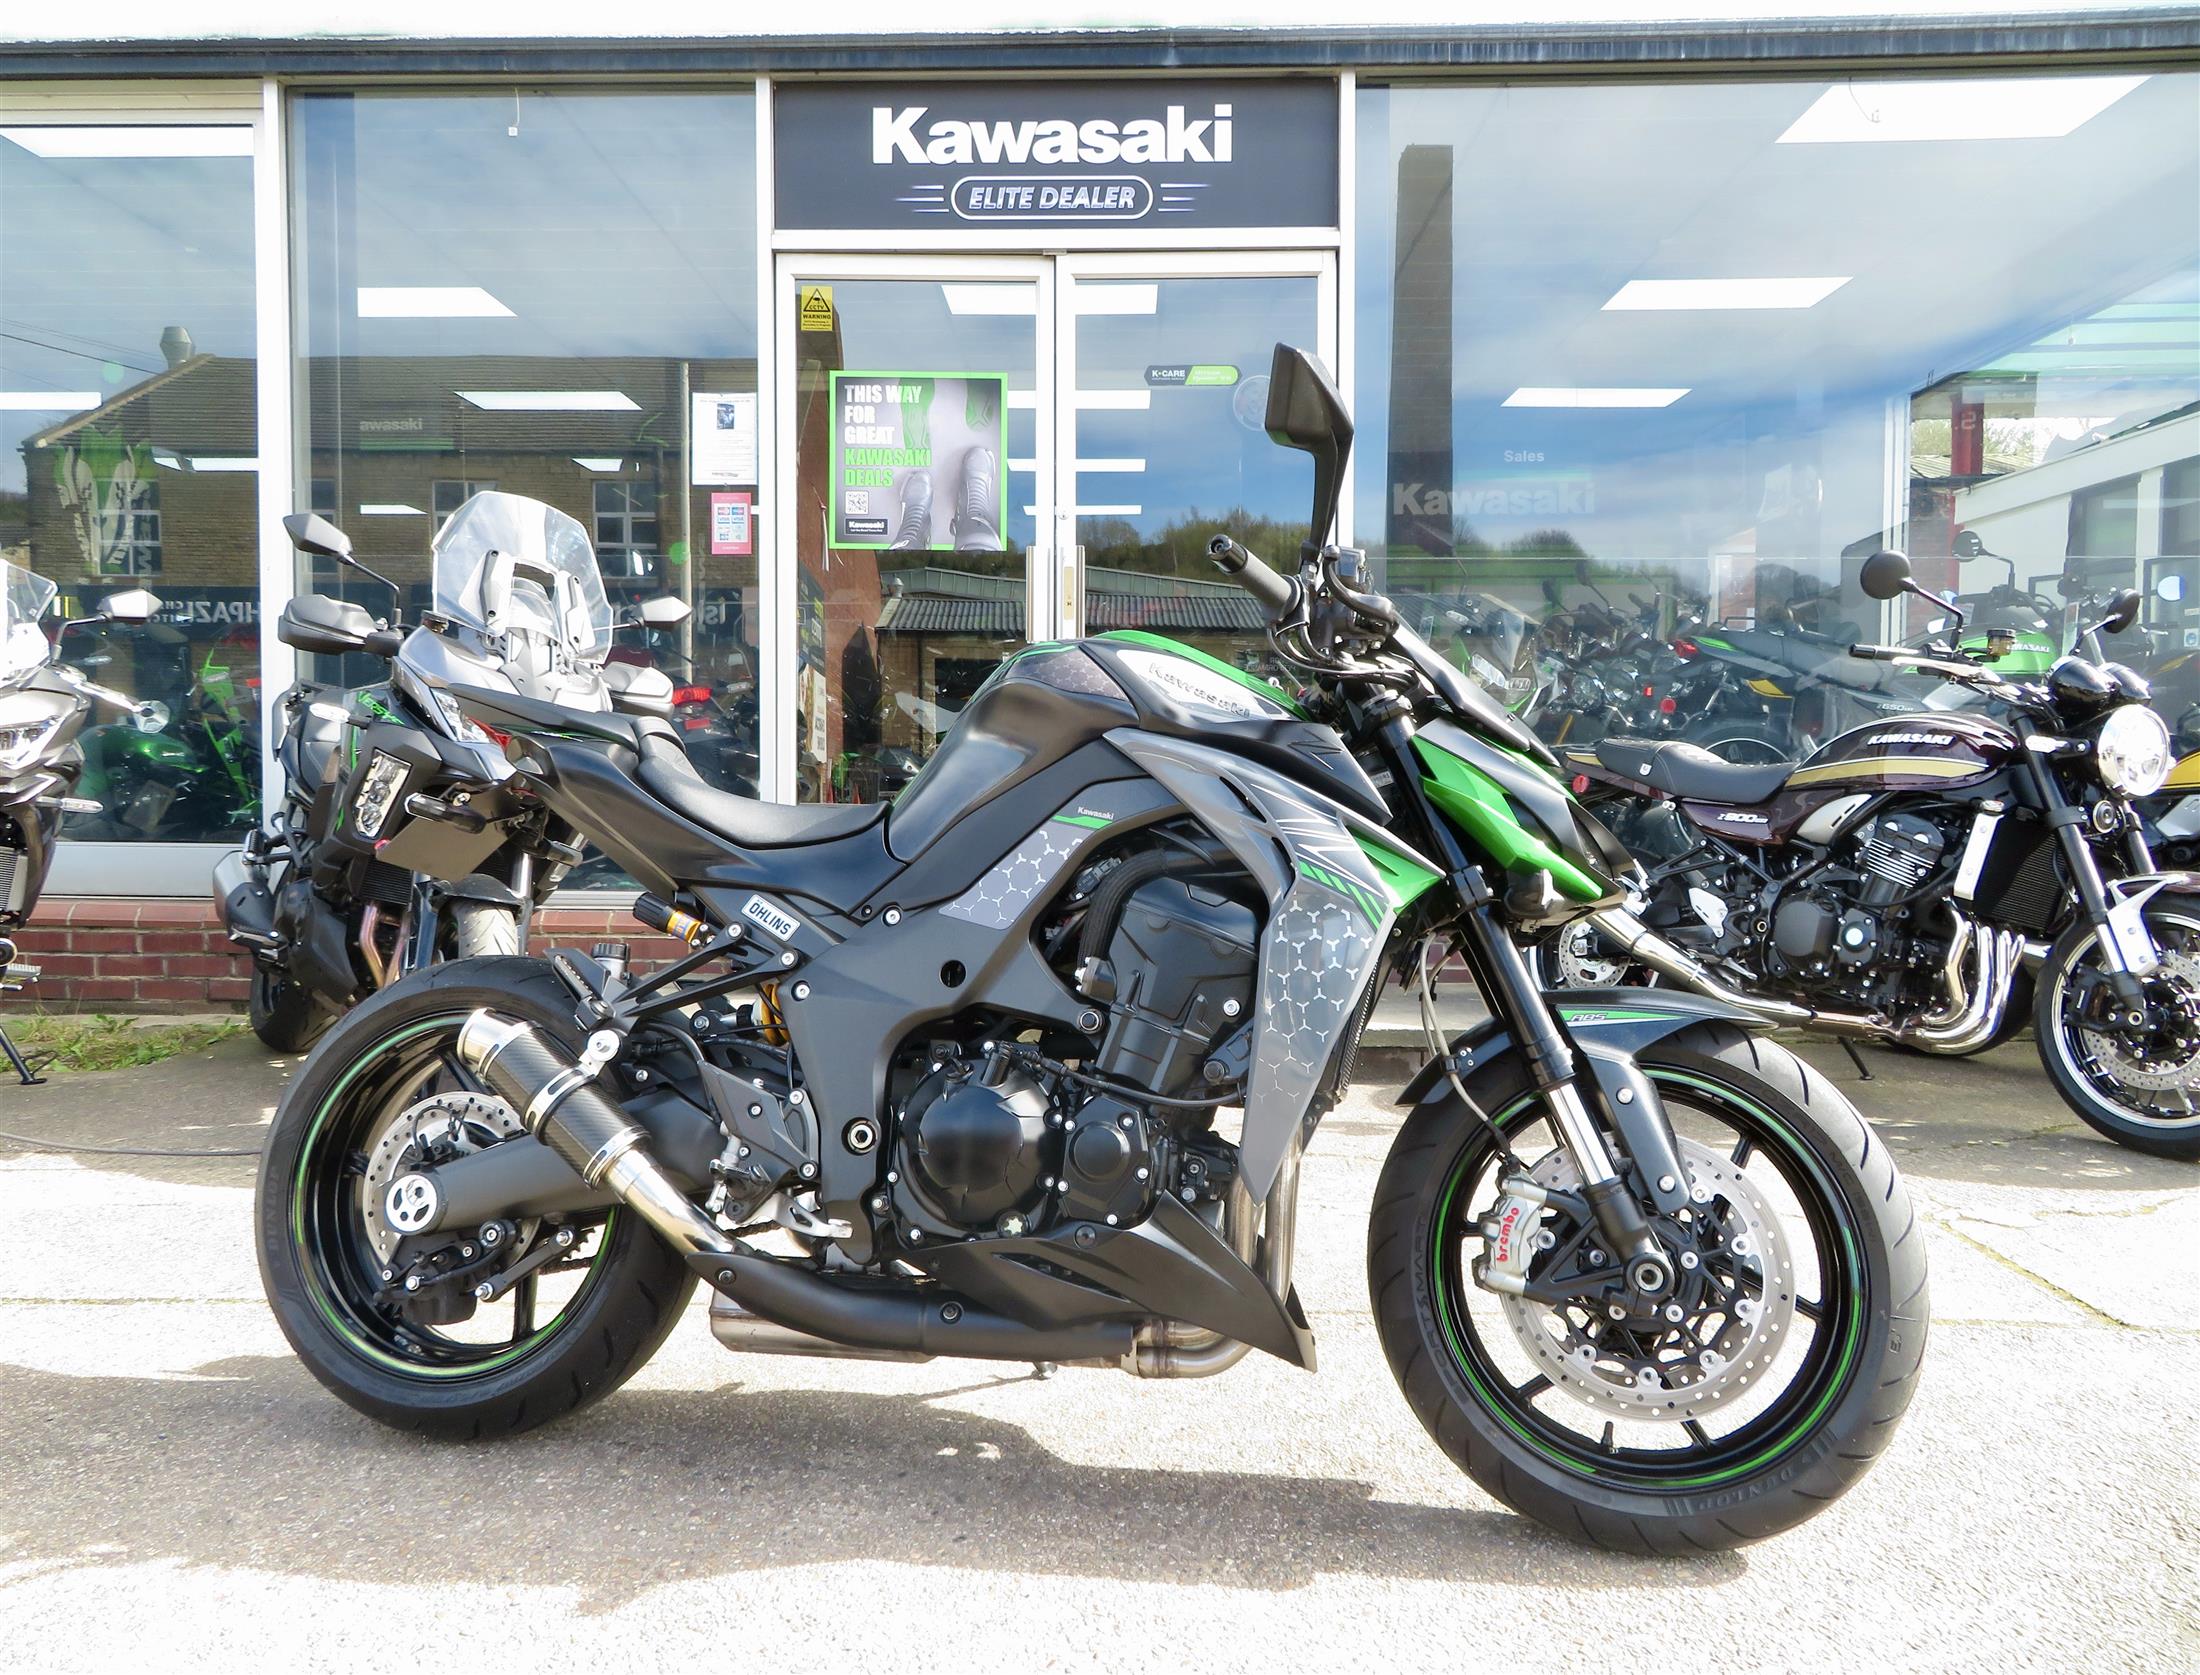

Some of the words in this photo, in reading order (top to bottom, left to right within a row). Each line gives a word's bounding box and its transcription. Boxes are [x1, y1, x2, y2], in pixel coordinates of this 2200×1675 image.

[872, 103, 1233, 165] Kawasaki
[968, 186, 1035, 209] ELITE
[1038, 186, 1137, 209] DEALER
[844, 384, 884, 403] THIS
[885, 385, 922, 404] WAY
[844, 405, 875, 424] FOR
[359, 418, 424, 432] awasaki
[844, 426, 895, 445] GREAT
[844, 448, 932, 467] KAWASAKI
[1503, 450, 1545, 463] Sales
[844, 468, 894, 487] DEALS
[1393, 482, 1596, 516] Kawasaki
[848, 520, 885, 530] Kawasaki
[1149, 662, 1250, 718] Kawasaki
[1866, 733, 1955, 746] KAWASAKI
[1077, 806, 1114, 820] Kawasaki
[1571, 1013, 1607, 1022] ABS
[1496, 1205, 1521, 1263] brembo
[1699, 1467, 1793, 1510] DUNLOP
